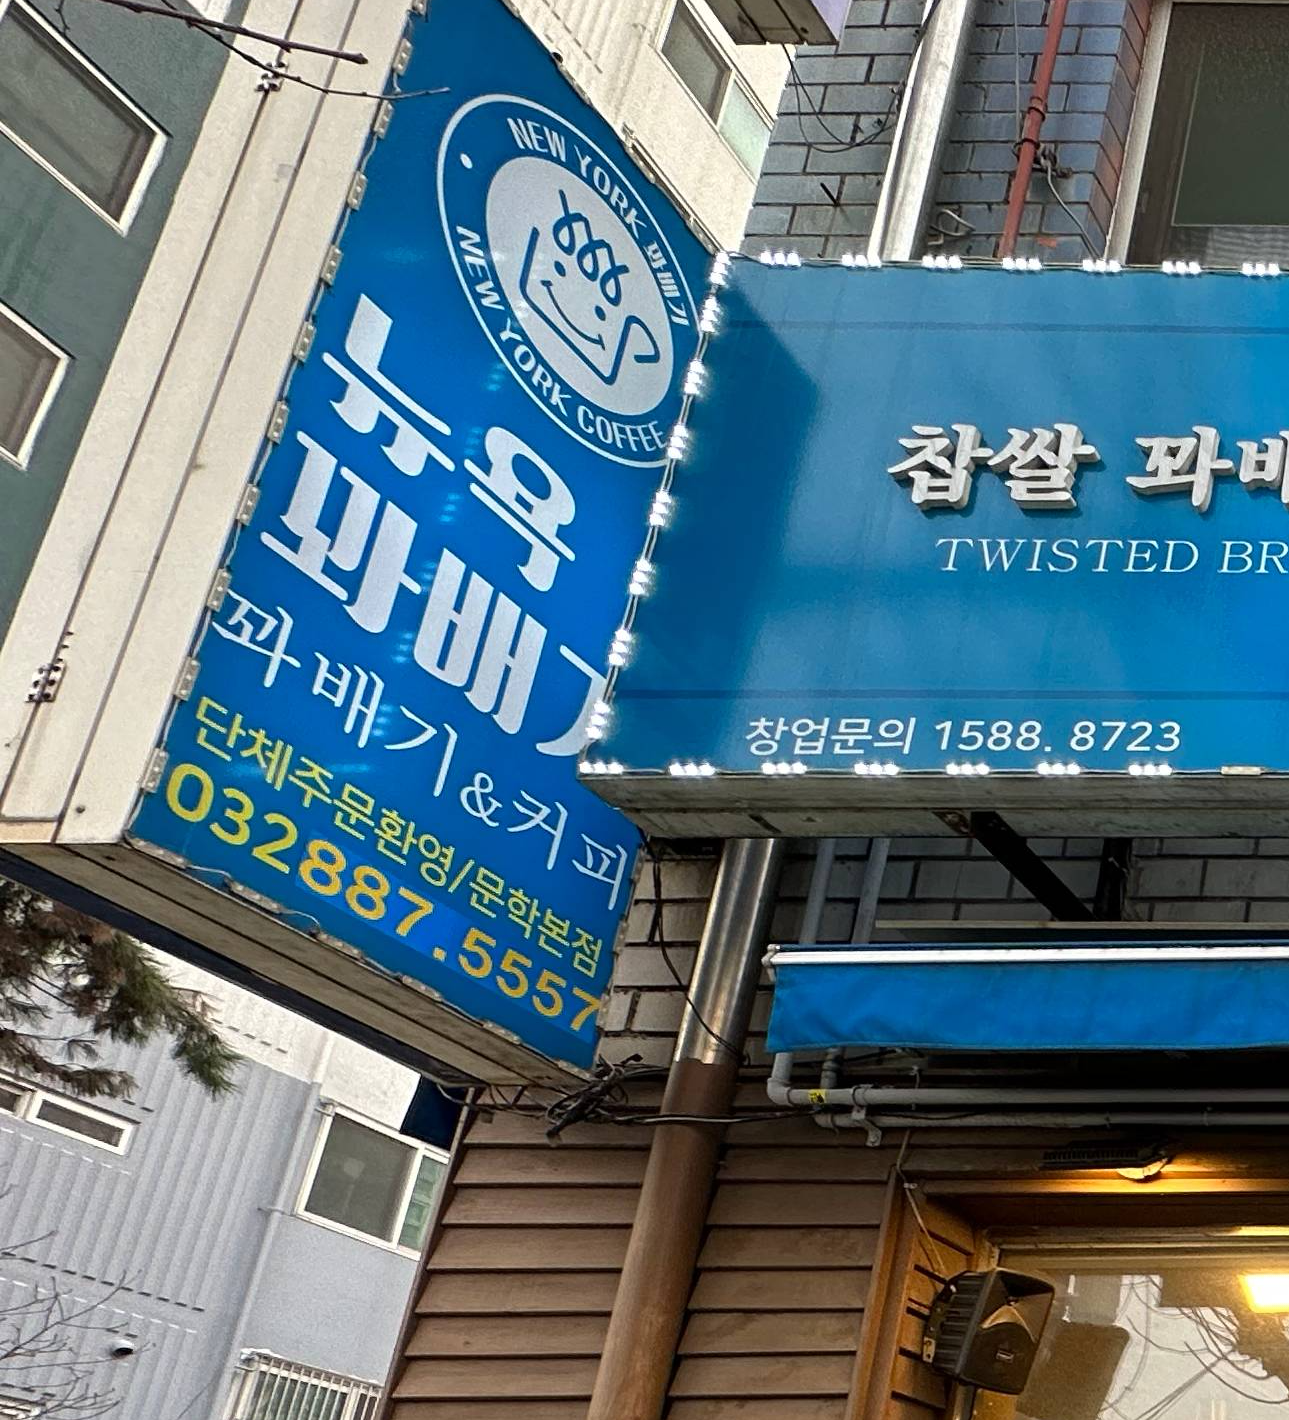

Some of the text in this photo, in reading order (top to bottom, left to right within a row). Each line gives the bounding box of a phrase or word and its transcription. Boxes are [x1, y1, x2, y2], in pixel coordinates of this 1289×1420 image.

[507, 118, 566, 161] NEW
[574, 145, 647, 238] YORK
[456, 225, 669, 452] NEW YORK COFFEE
[322, 294, 575, 592] 뉴욕
[887, 422, 1102, 514] 찹쌀
[937, 537, 1200, 574] TWISTED
[745, 717, 916, 757] 창업문의
[1068, 719, 1182, 754] 8723
